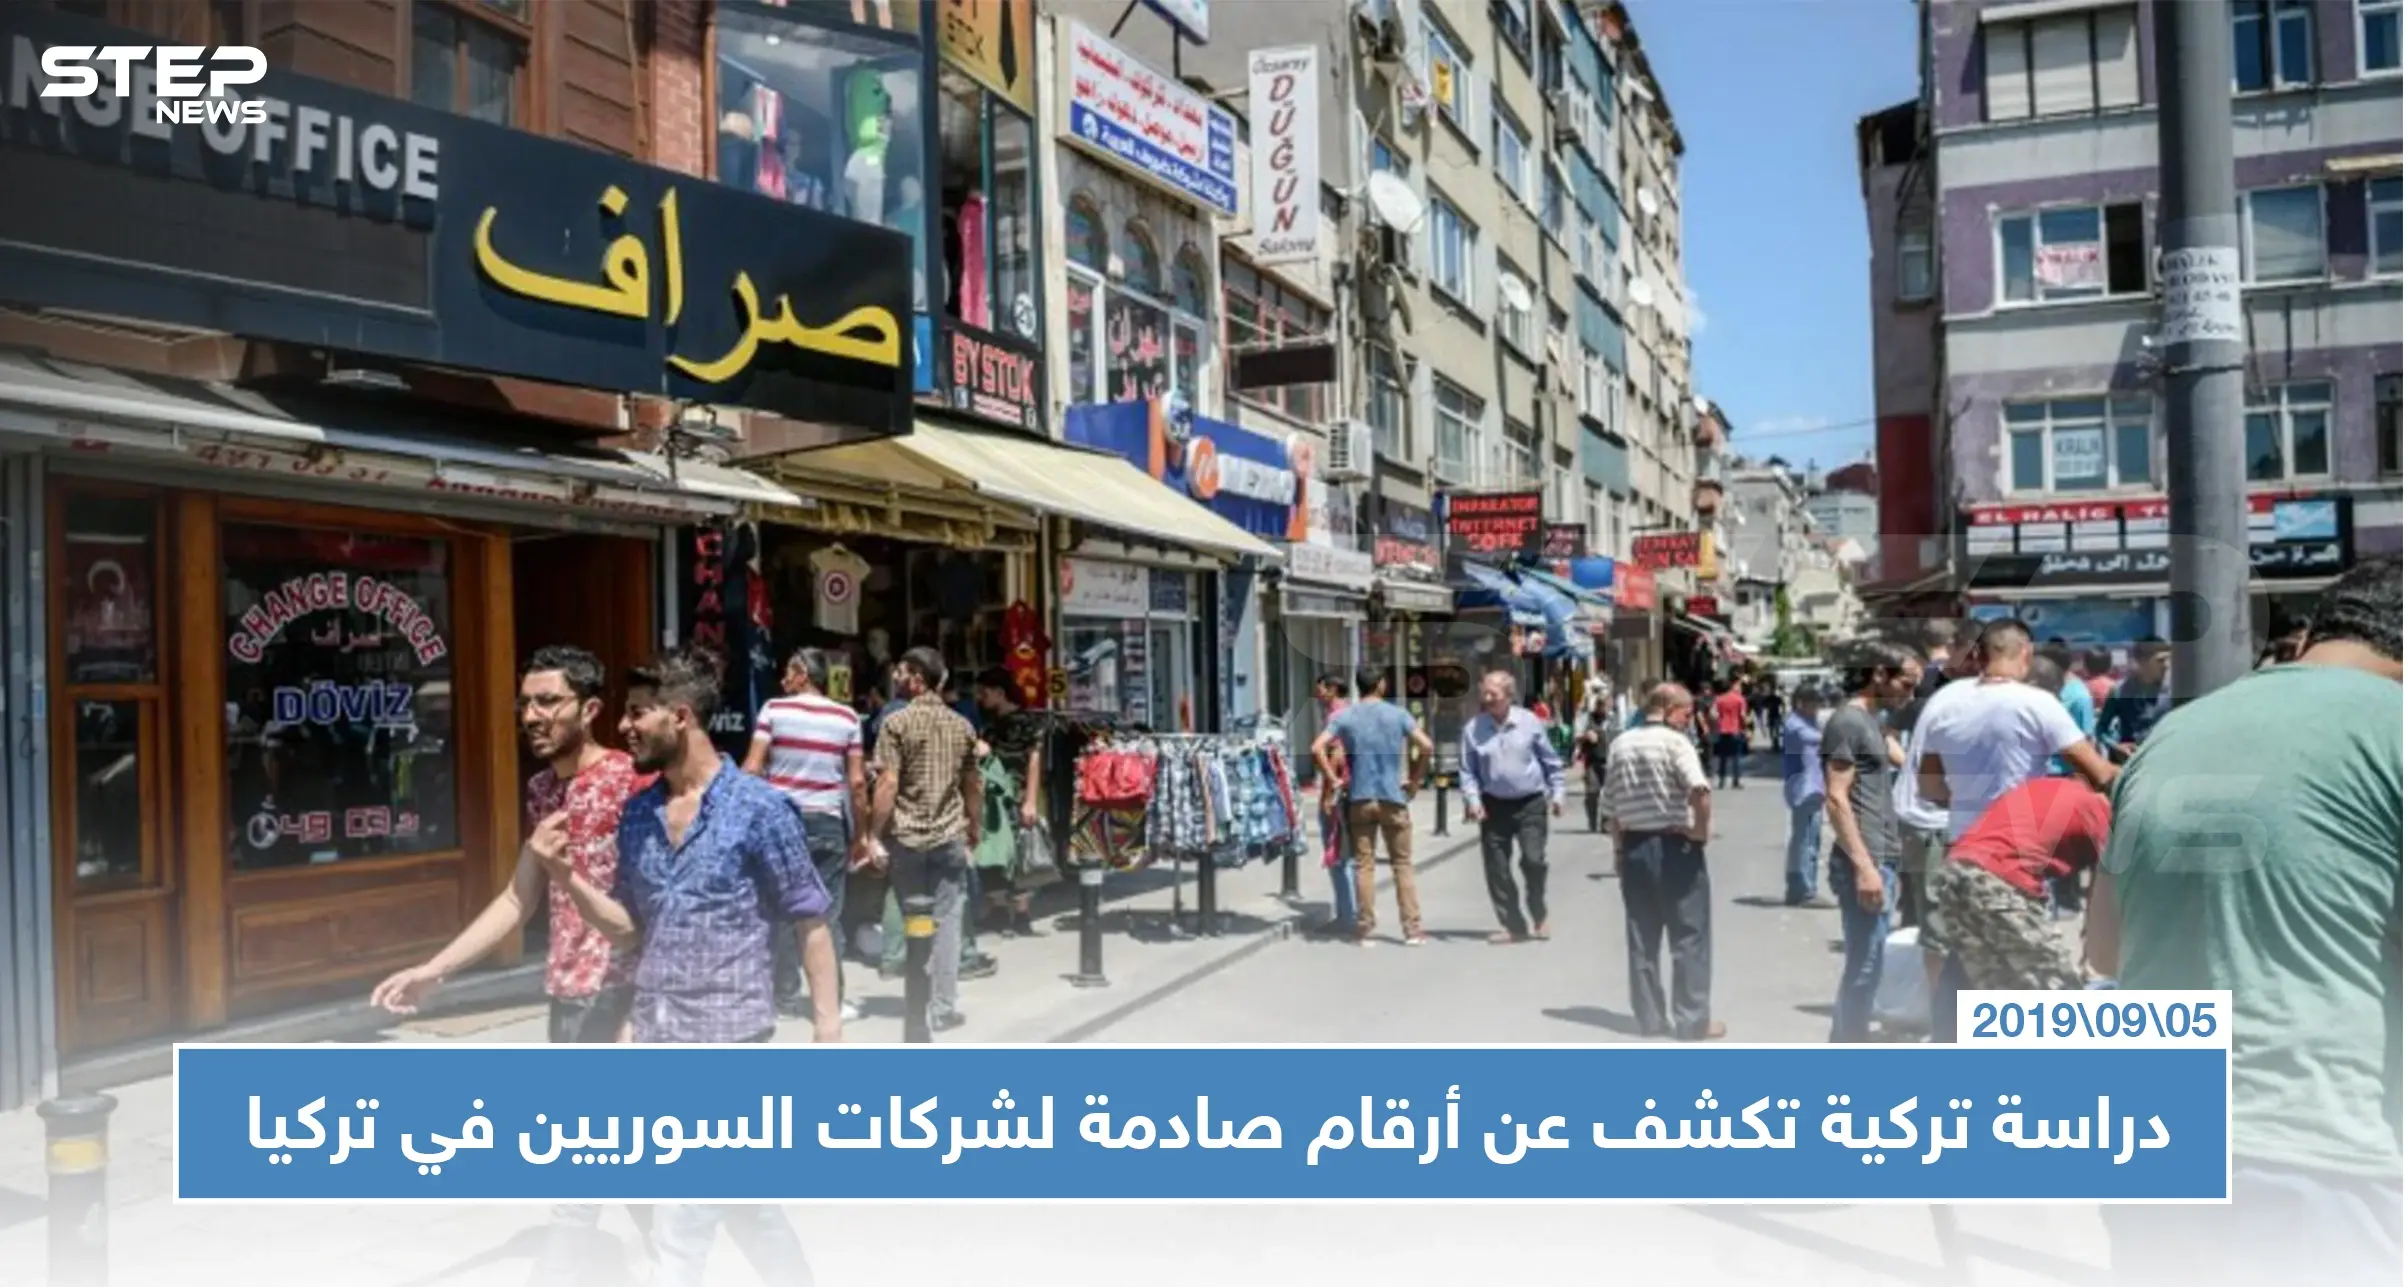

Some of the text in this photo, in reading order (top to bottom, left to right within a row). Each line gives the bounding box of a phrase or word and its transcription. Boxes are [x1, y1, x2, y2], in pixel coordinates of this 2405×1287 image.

[201, 86, 439, 199] OFFICE
[1269, 74, 1298, 233] DÜĞÜN
[473, 185, 900, 383] صراف
[229, 571, 447, 666] CHANGE OFFICE
[273, 679, 414, 725] DÖVİZ
